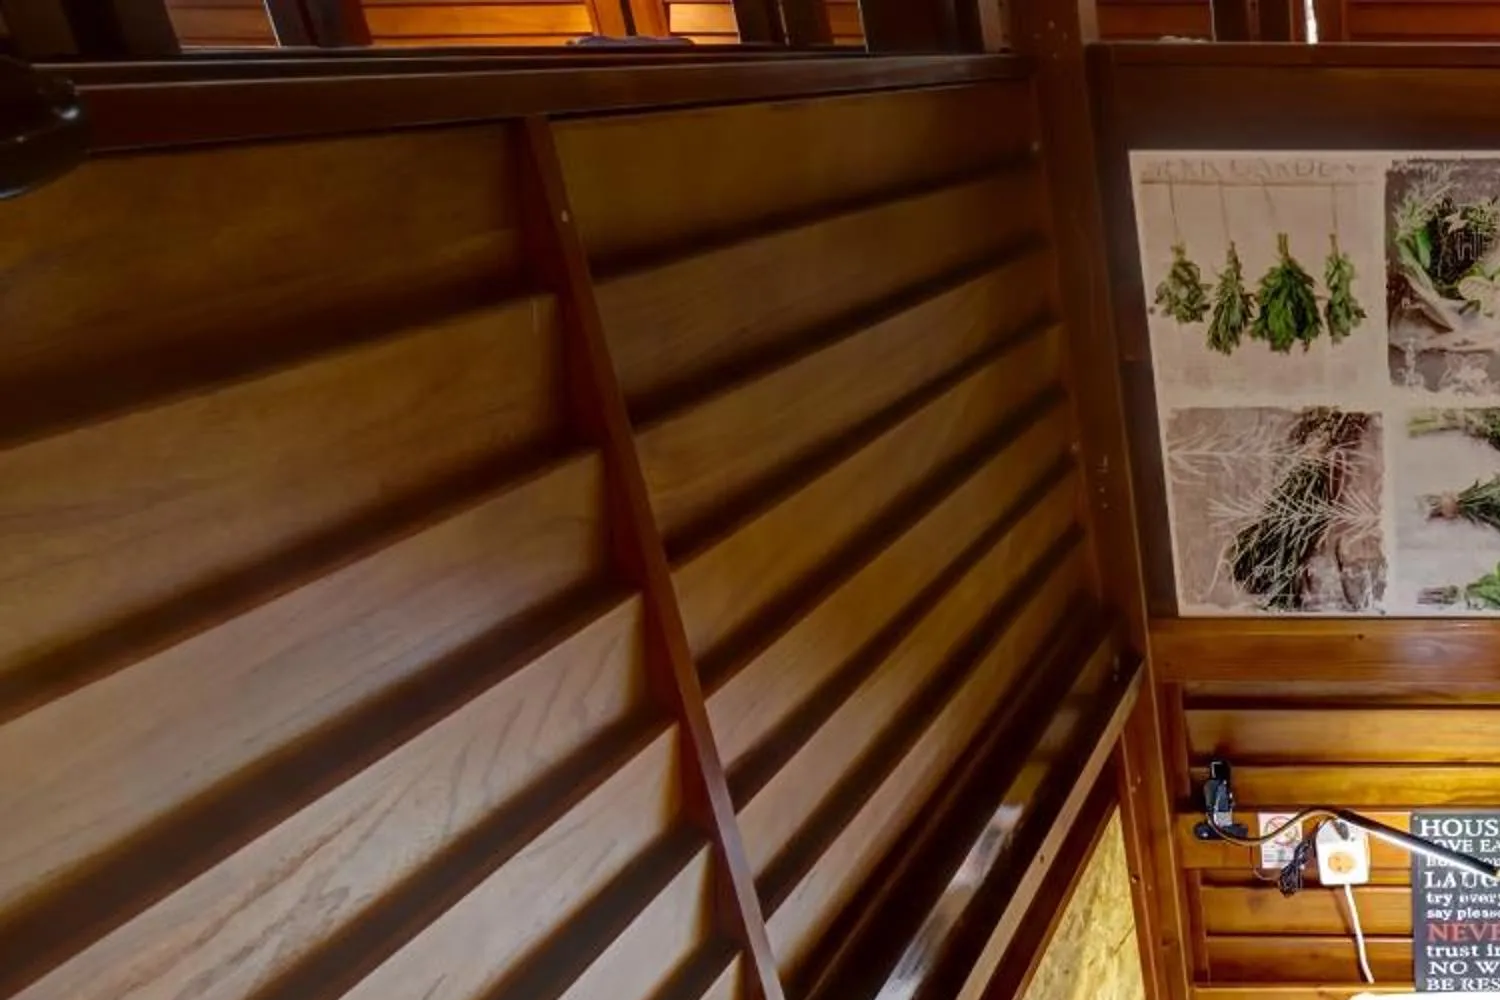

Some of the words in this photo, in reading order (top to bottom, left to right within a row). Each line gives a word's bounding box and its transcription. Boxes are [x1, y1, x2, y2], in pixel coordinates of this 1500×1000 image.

[1426, 891, 1453, 906] try
[1426, 910, 1453, 921] say
[1426, 944, 1479, 958] trust
[1429, 960, 1468, 975] NO
[1427, 977, 1455, 991] BE
